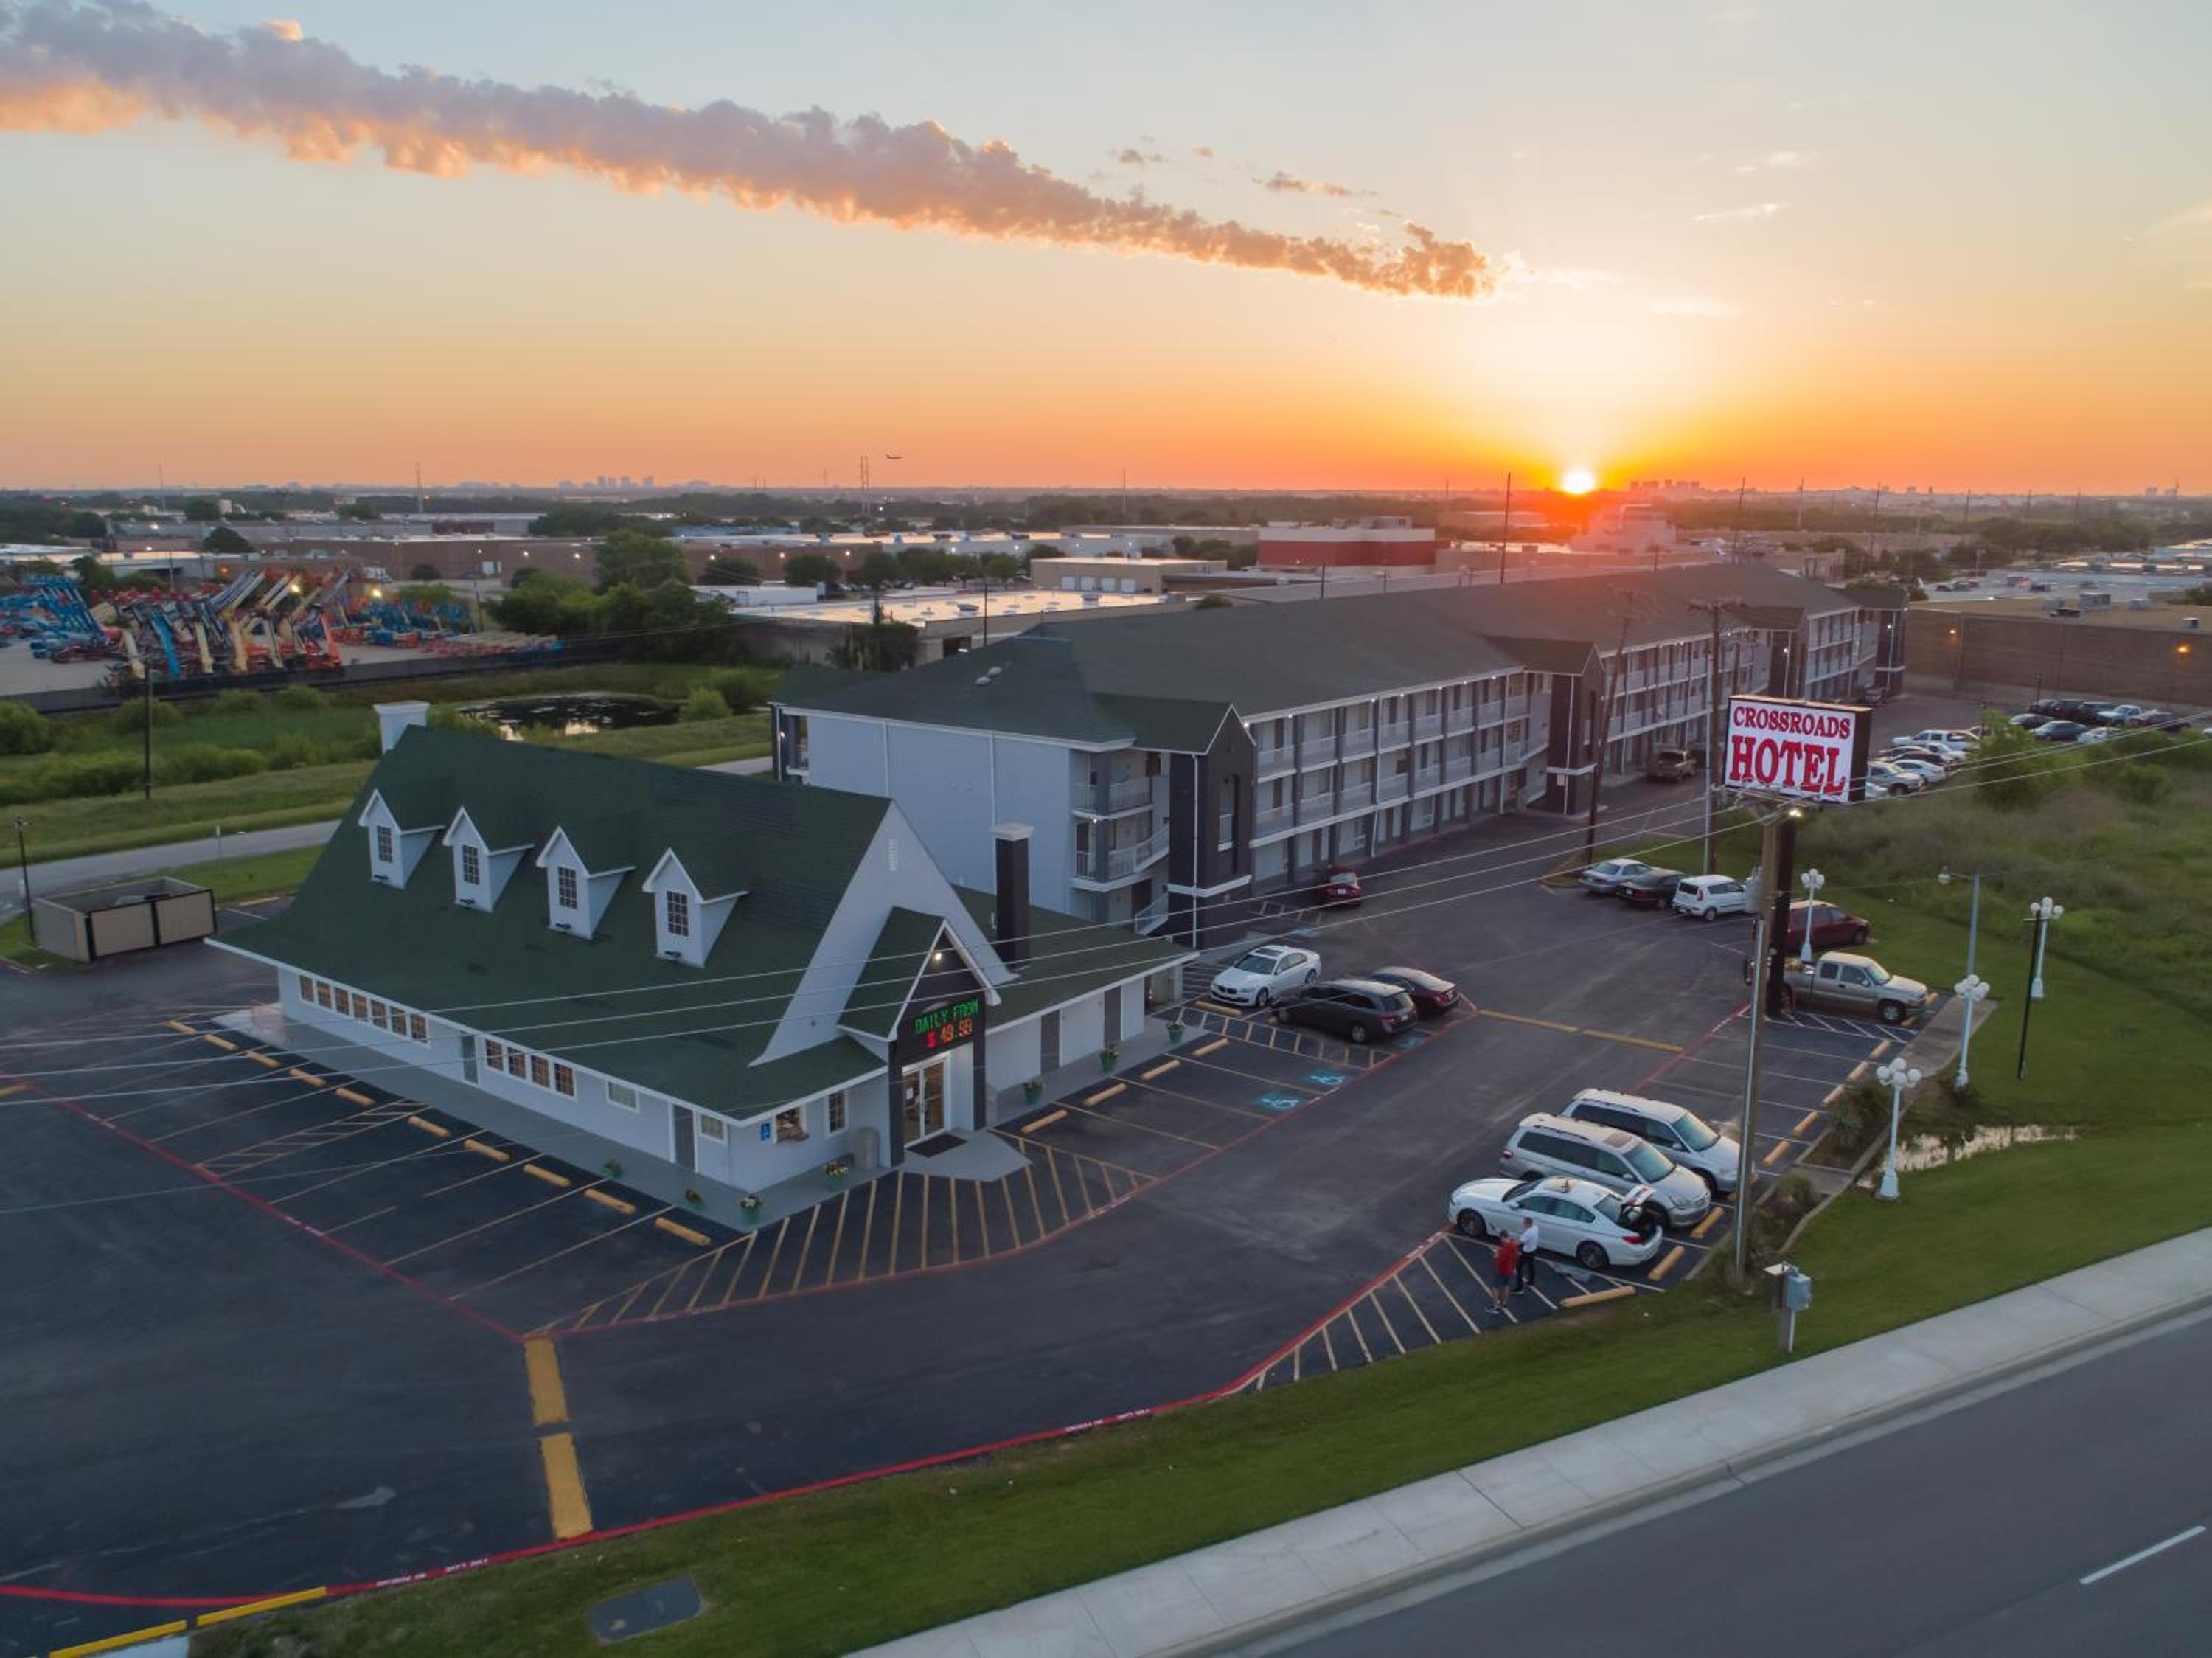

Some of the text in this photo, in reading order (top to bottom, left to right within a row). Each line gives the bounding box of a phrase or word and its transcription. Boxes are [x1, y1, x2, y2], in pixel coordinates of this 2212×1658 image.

[1733, 706, 1851, 740] CROSSROADS
[1729, 735, 1846, 795] HOTEL
[914, 998, 979, 1034] DAILY FROM
